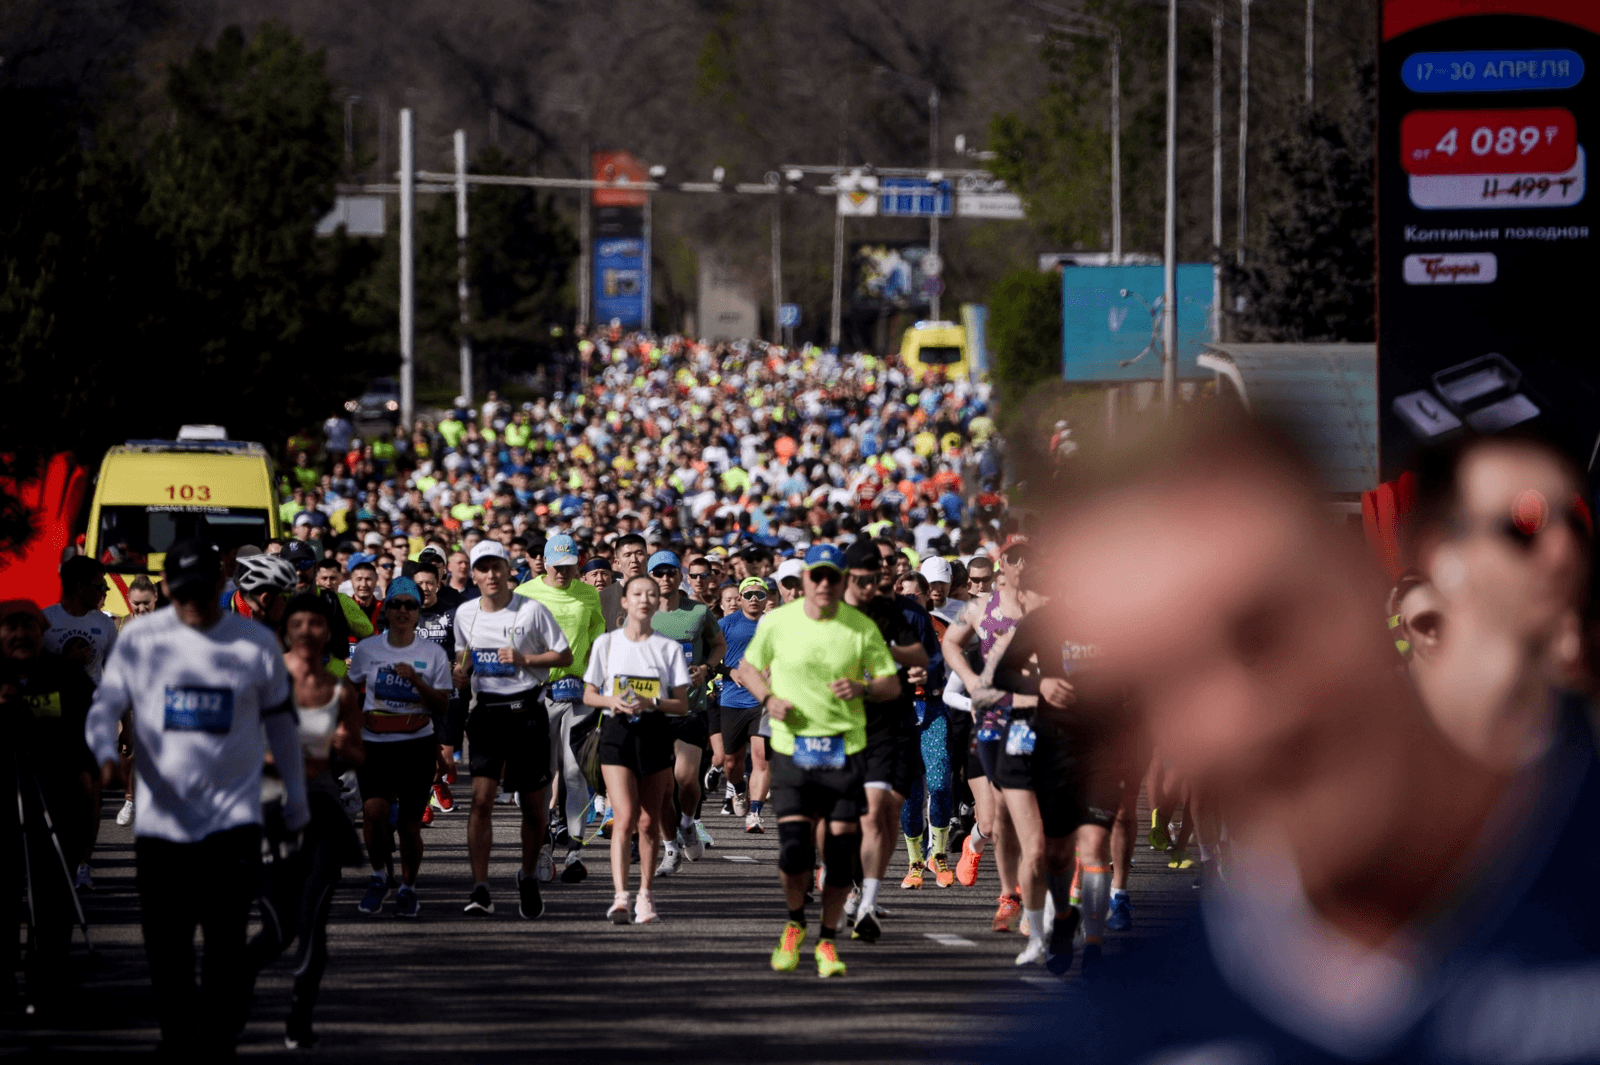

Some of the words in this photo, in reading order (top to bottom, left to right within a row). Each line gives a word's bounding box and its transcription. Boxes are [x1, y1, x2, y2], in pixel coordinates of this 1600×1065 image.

[1482, 59, 1570, 79] АПРЕЛЯ
[1435, 126, 1459, 157] 4
[1469, 125, 1541, 157] 089
[1403, 224, 1499, 243] Коптильня
[1504, 225, 1590, 242] походная
[165, 484, 212, 501] 103
[58, 629, 96, 645] KOSTANAY
[805, 737, 831, 752] 142
